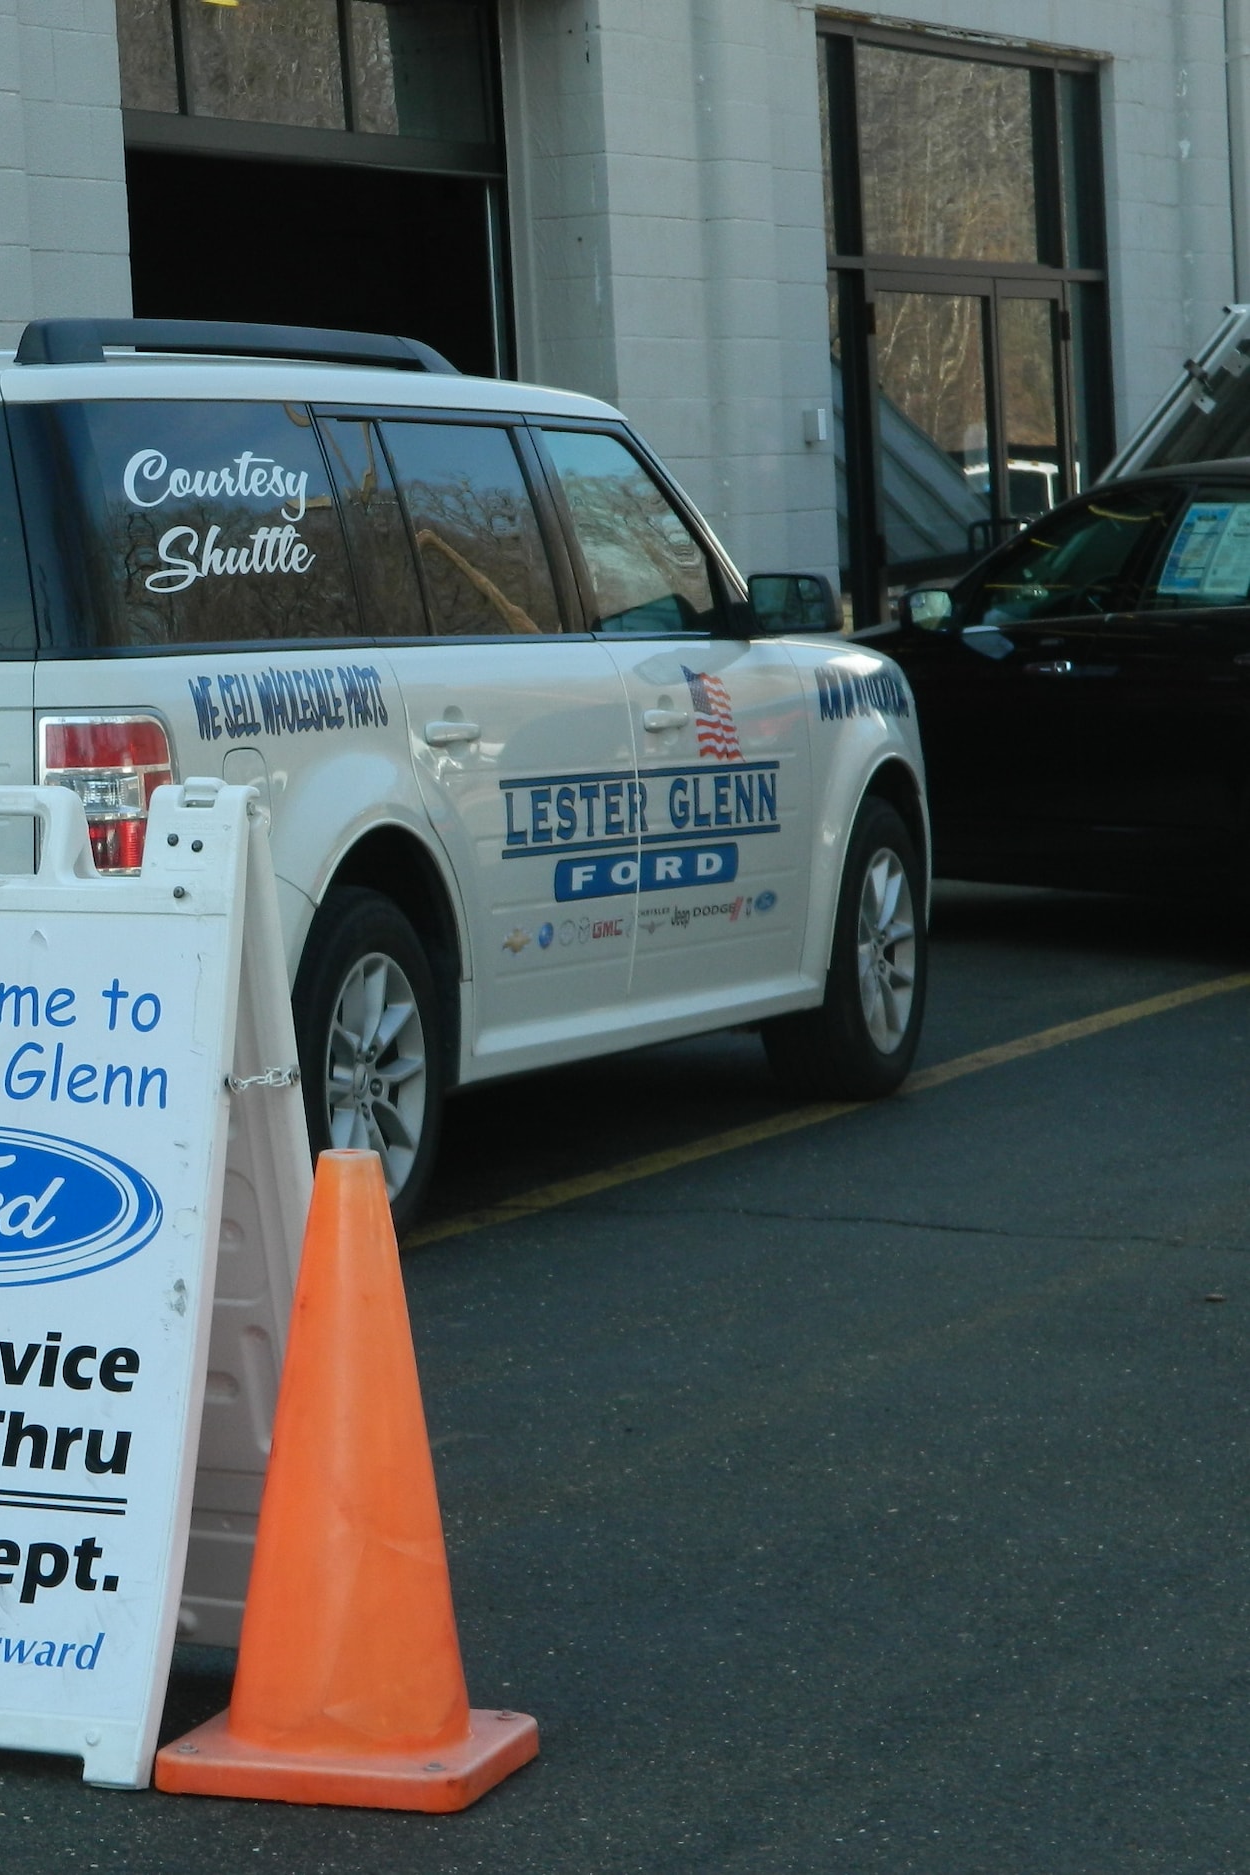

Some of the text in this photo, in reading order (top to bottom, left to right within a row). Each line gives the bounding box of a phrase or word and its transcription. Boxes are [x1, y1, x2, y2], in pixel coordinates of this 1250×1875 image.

[123, 448, 309, 522] Courtesy
[144, 524, 317, 594] Shuttle
[188, 664, 389, 741] WE SELL WHOLESALE PARTS
[506, 772, 778, 846] LESTER GLENN
[571, 852, 723, 891] FORD
[592, 918, 623, 939] GMC
[693, 903, 736, 918] DODGE
[101, 976, 162, 1033] to
[4, 1041, 169, 1109] Glenn
